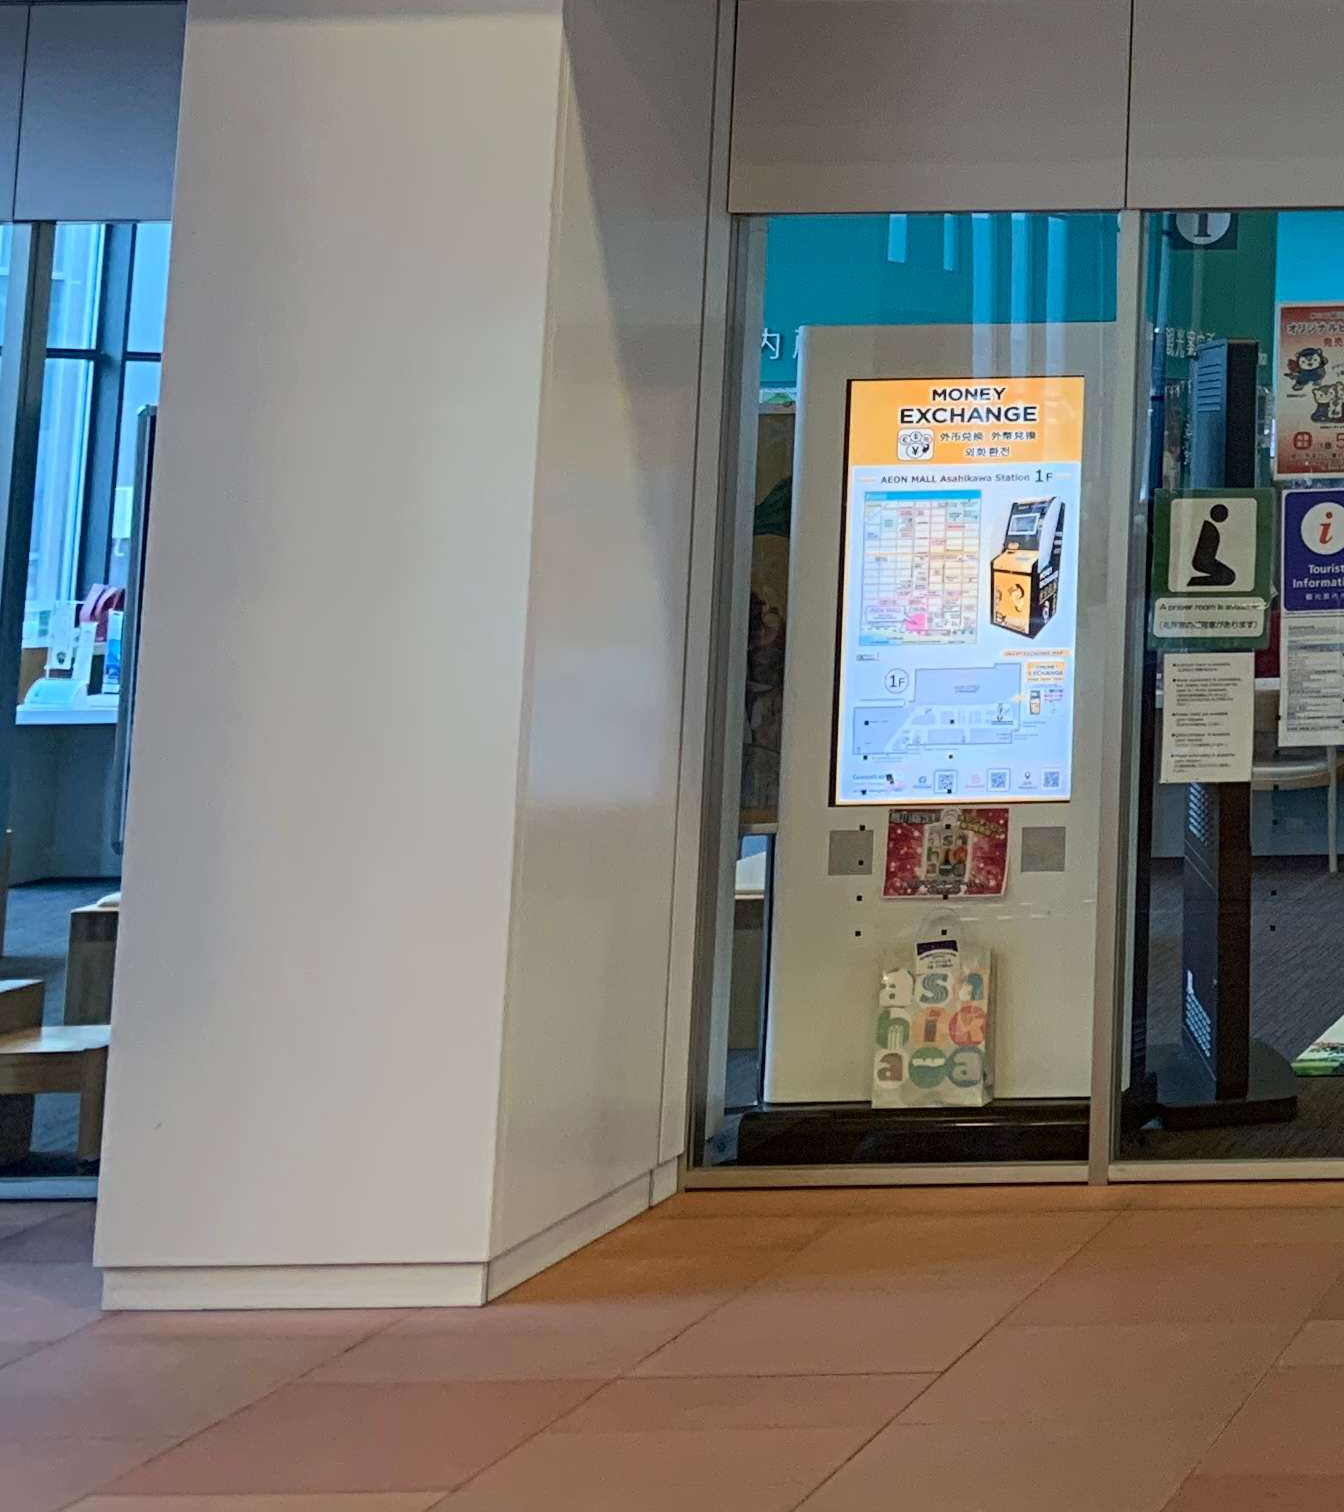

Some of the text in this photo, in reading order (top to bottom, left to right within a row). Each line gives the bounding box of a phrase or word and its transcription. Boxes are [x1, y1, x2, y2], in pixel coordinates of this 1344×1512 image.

[931, 387, 1007, 402] MONEY
[899, 406, 1038, 424] EXCHANGE
[880, 469, 1053, 484] AEON MALL Asahikawa Station 1F
